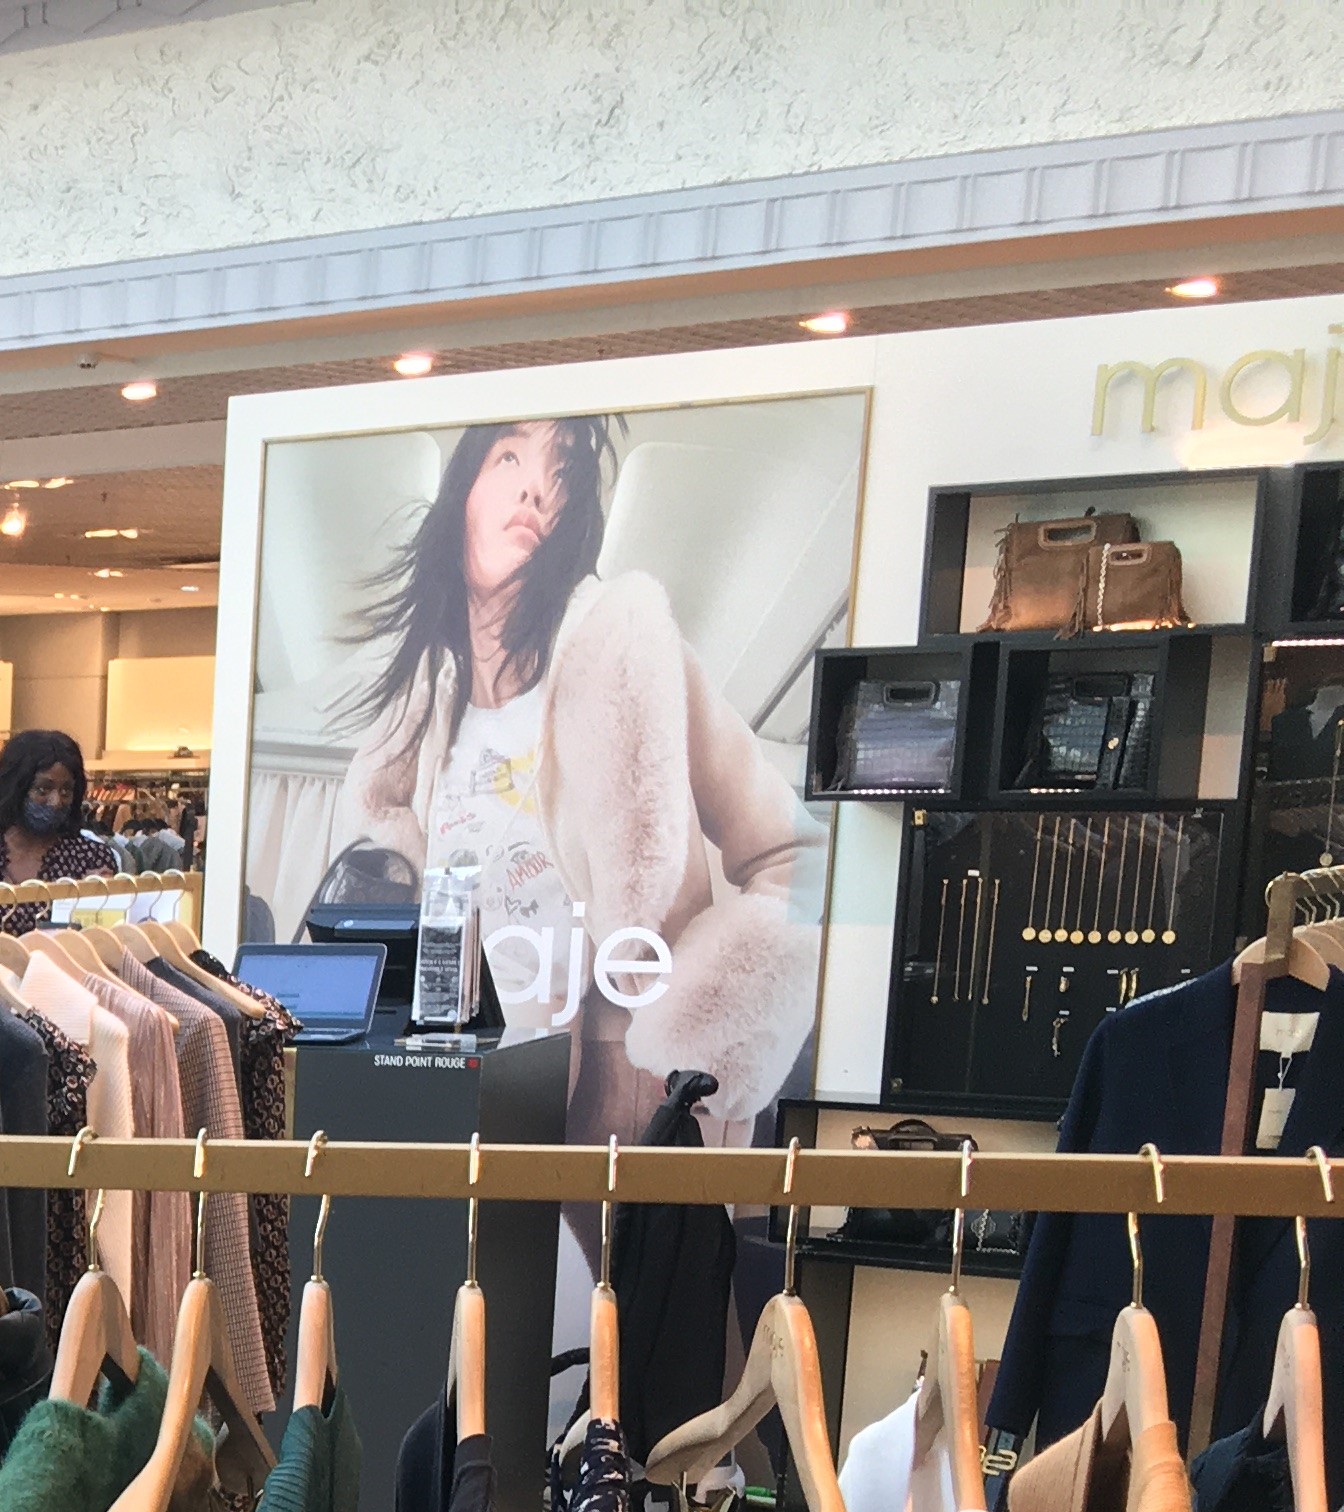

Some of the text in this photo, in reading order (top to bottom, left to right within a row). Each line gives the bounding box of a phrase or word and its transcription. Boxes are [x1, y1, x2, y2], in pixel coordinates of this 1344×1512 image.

[506, 850, 554, 893] AMOUR
[482, 901, 673, 1028] aje
[374, 1055, 466, 1069] STAND POINT ROUGE
